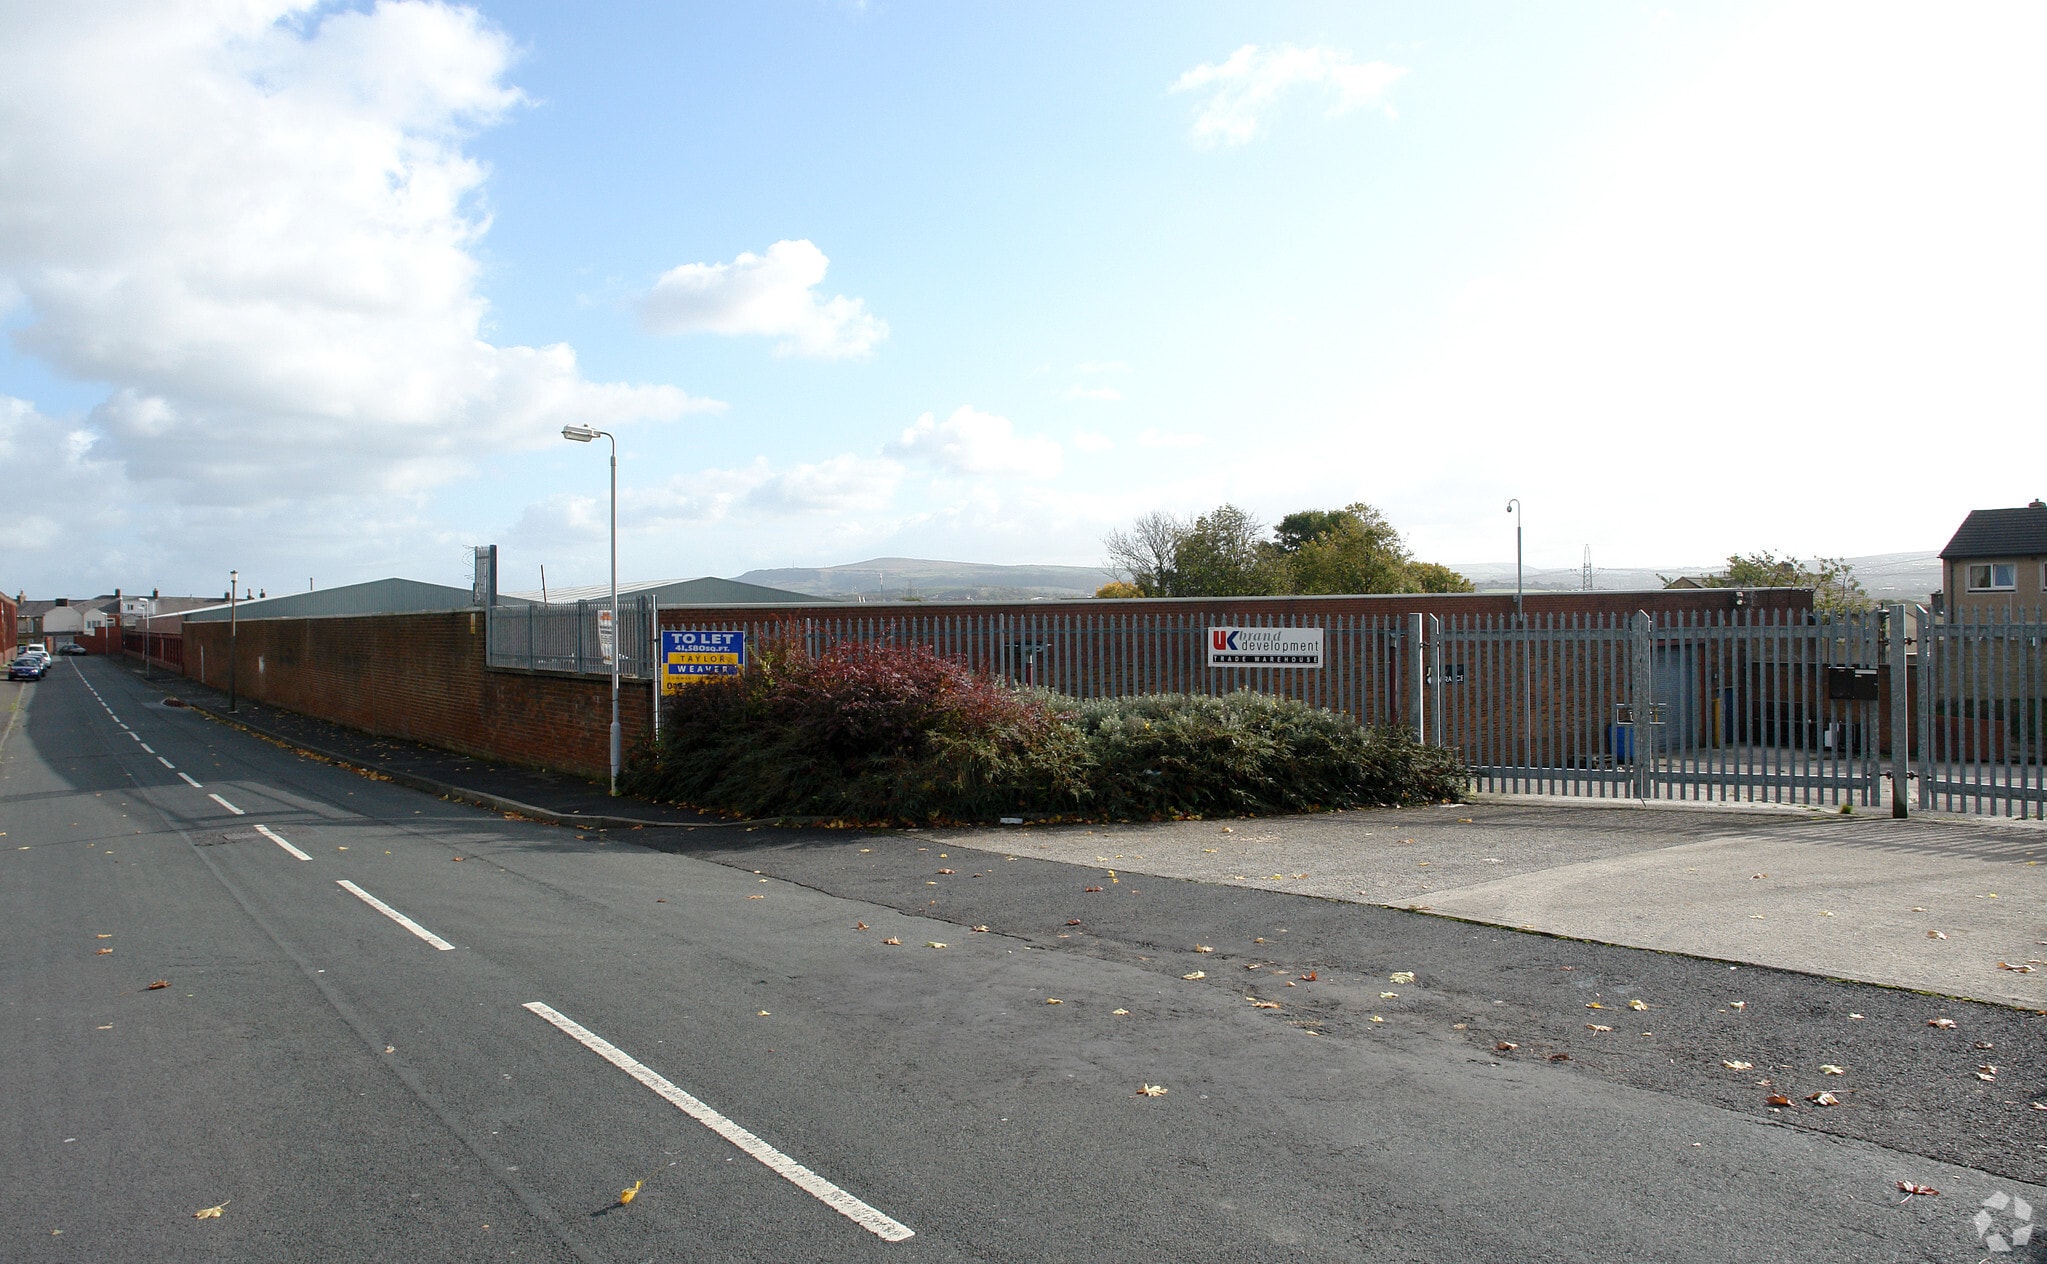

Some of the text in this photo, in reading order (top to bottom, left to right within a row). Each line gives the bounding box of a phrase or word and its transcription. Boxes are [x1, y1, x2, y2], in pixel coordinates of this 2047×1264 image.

[671, 633, 734, 644] TO LET
[1213, 631, 1282, 650] UK brand
[1242, 641, 1318, 652] development
[677, 665, 728, 673] WEAVER
